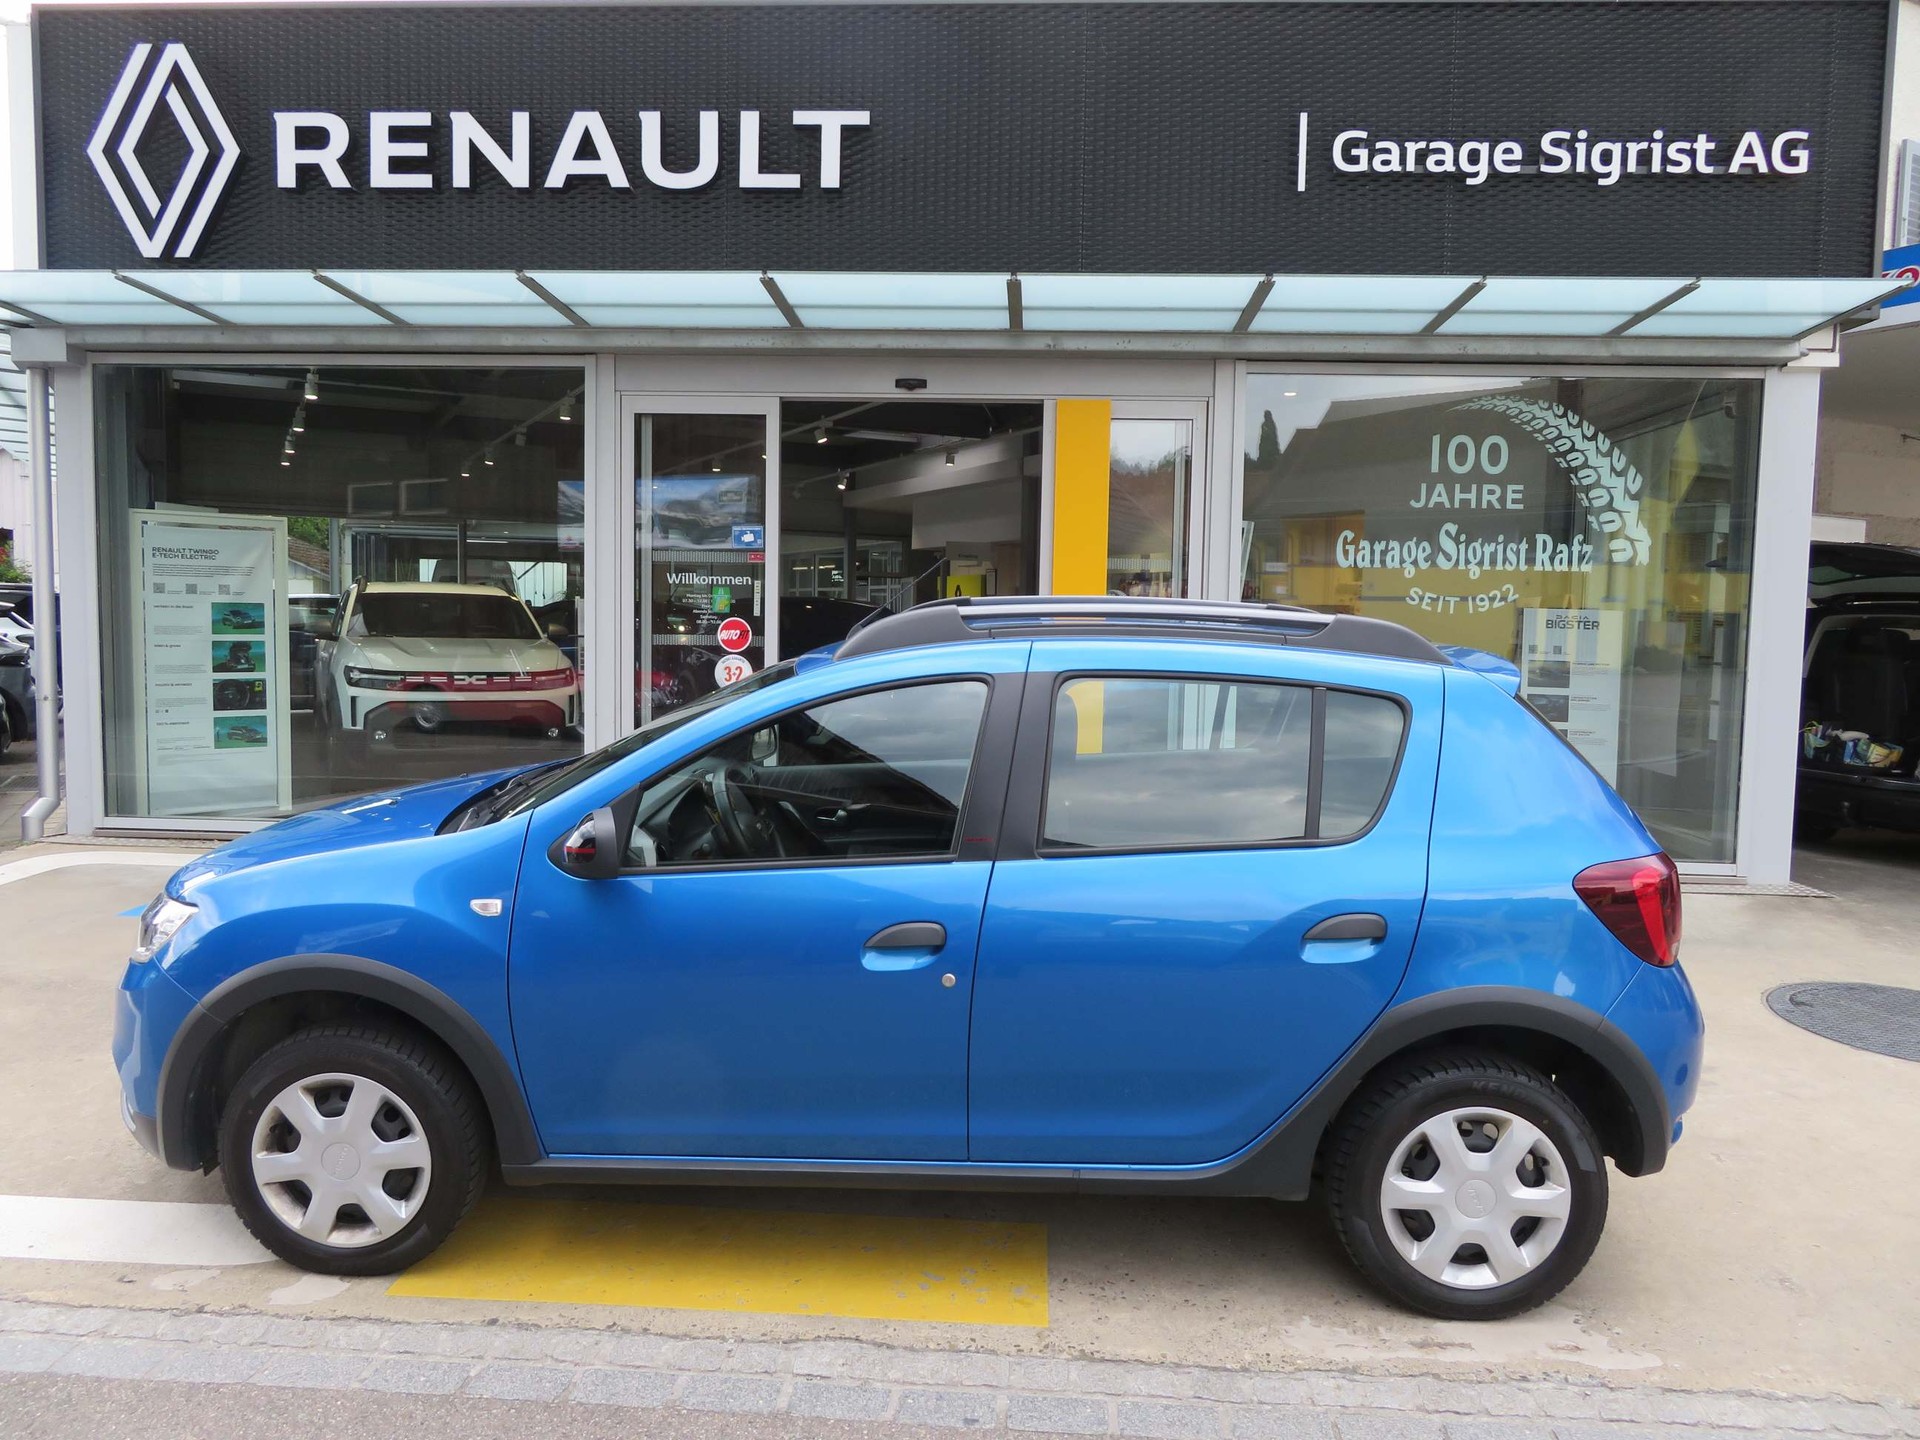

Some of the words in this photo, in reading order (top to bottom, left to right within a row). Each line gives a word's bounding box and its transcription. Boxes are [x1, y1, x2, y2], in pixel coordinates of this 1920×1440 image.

[273, 110, 871, 190] RENAULT
[1331, 129, 1523, 186] Garage
[1539, 128, 1716, 187] Sigrist
[1728, 130, 1810, 175] AG
[1430, 433, 1510, 475] 100
[1409, 483, 1525, 510] JAHRE
[152, 546, 187, 555] RENAULT
[152, 552, 180, 560] E-TECH
[180, 553, 217, 561] ELECTRIC
[1336, 529, 1432, 579] Garage
[1437, 521, 1529, 580] Sigrist
[1534, 532, 1594, 573] Rafz
[666, 572, 752, 585] Willkommen
[1406, 586, 1460, 615] SEIT
[1468, 583, 1520, 614] 1922
[719, 629, 750, 640] AUTOFIT
[1545, 619, 1600, 631] BIGSTER
